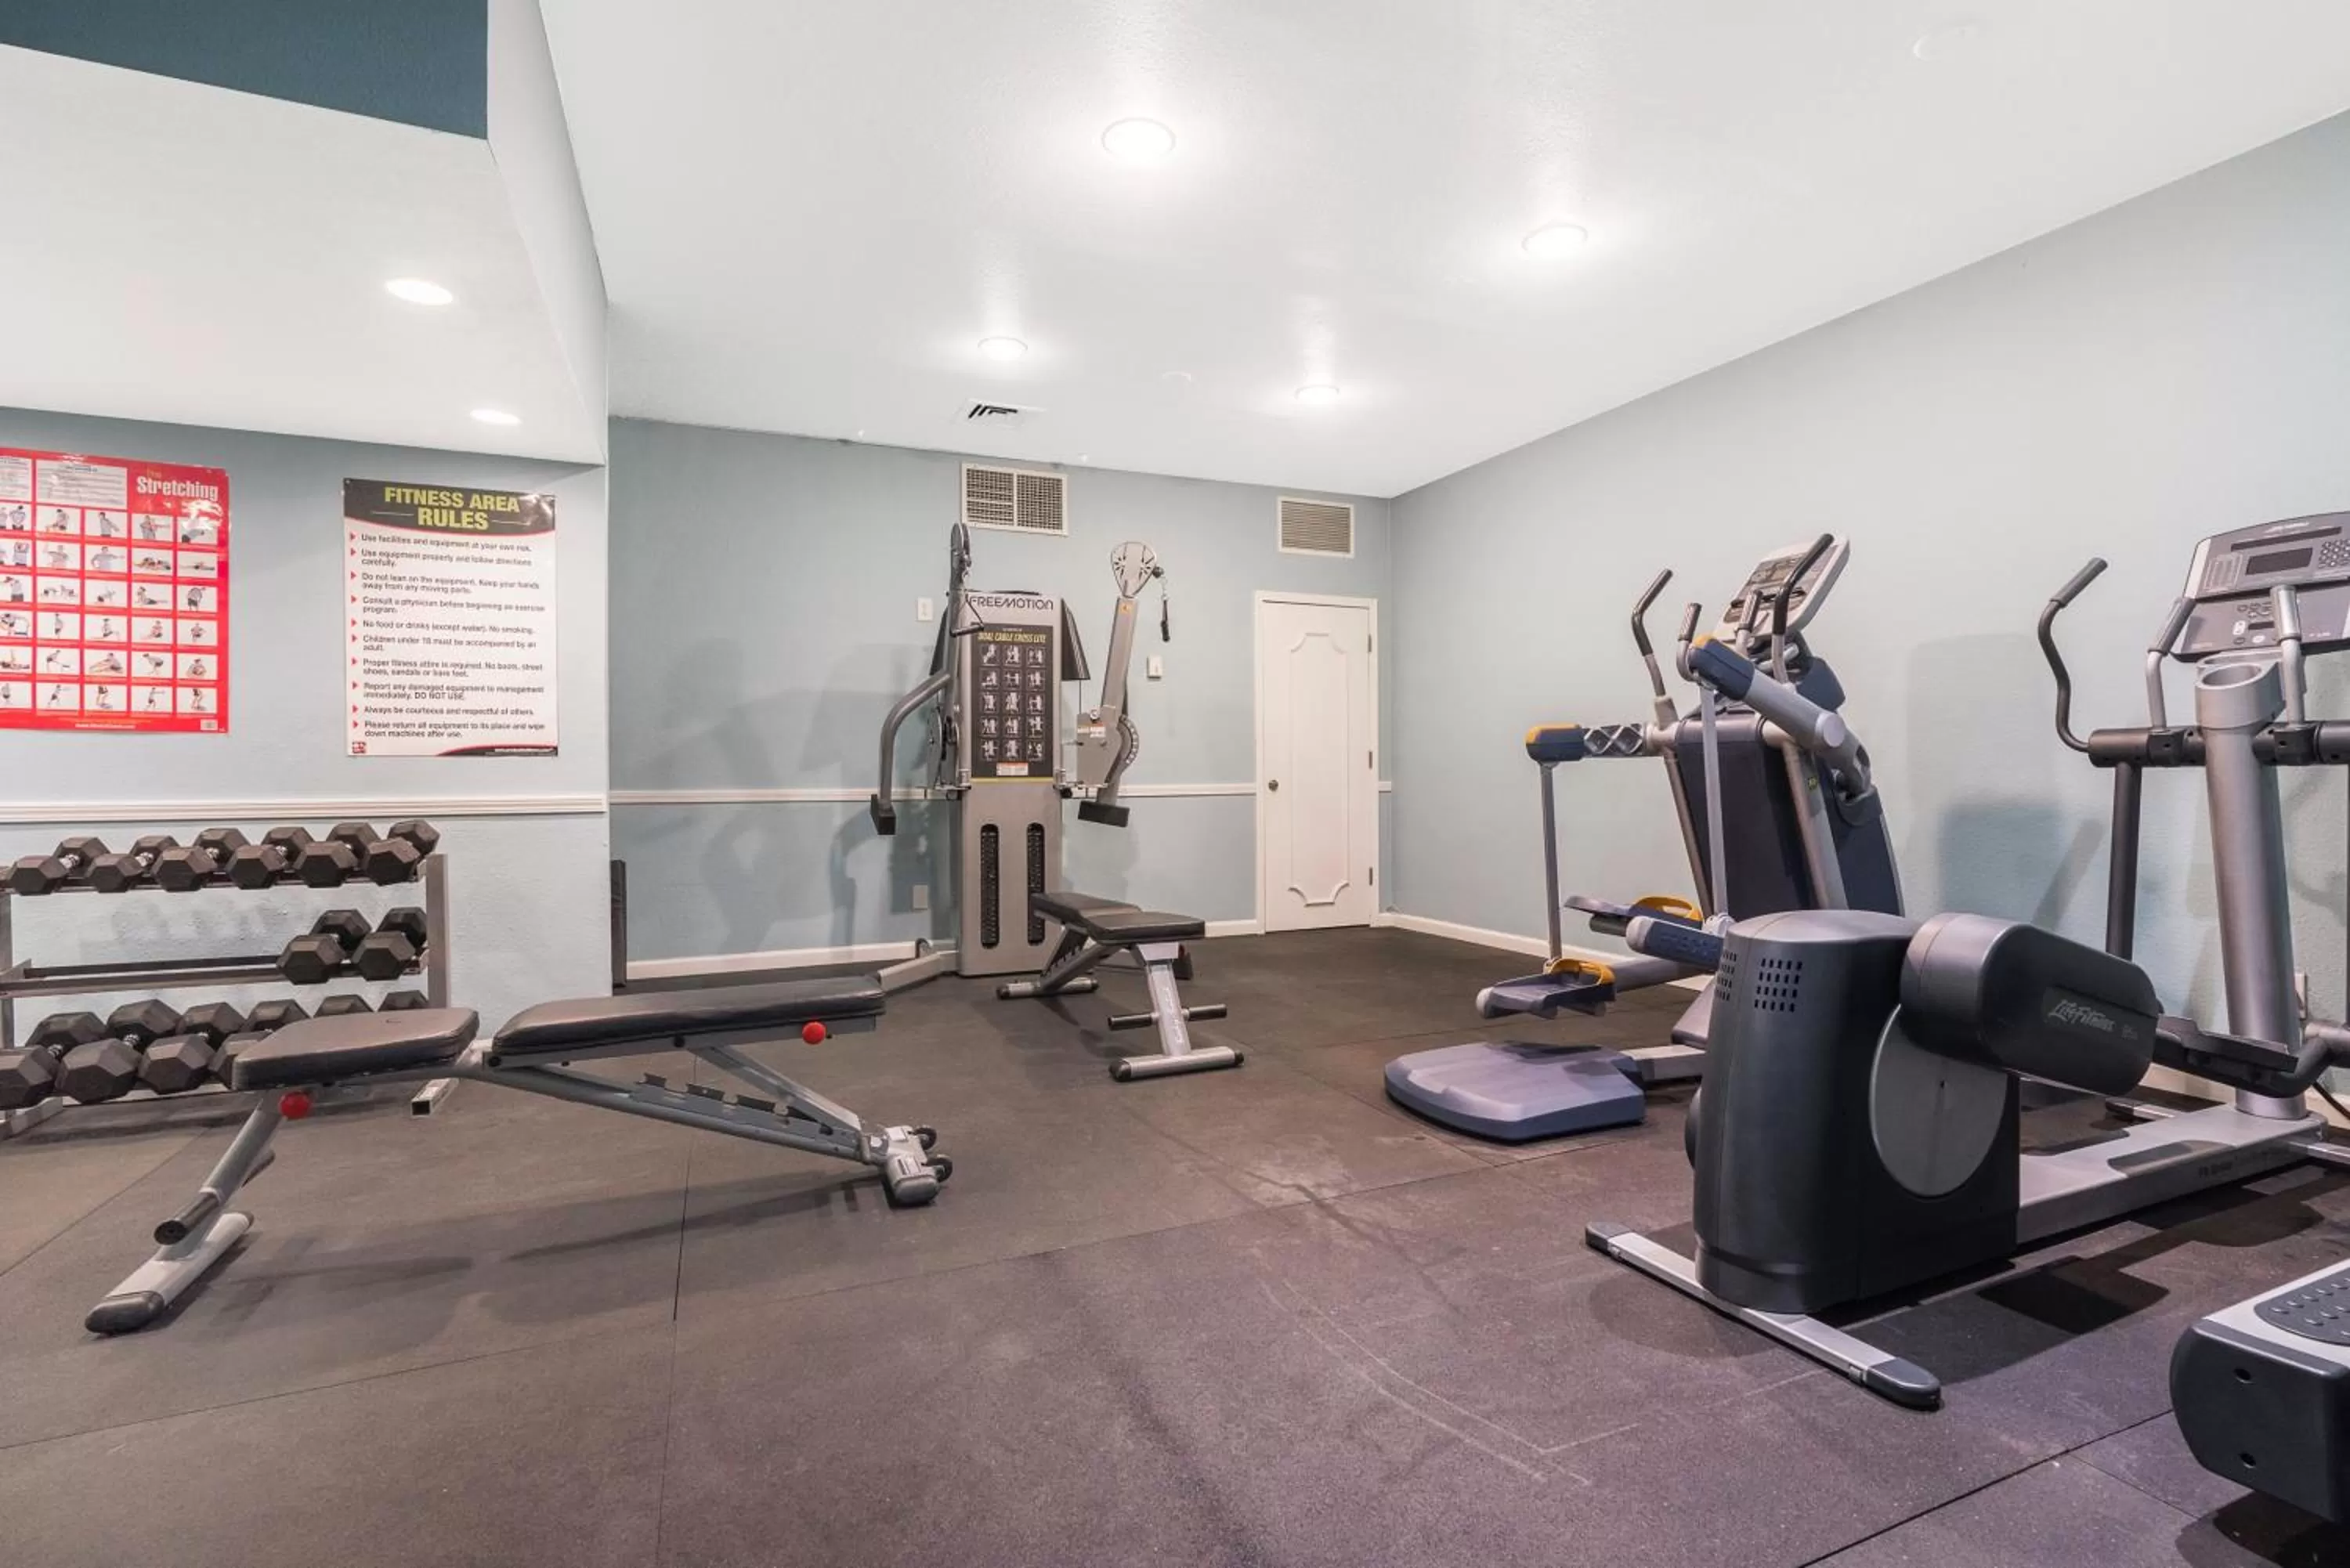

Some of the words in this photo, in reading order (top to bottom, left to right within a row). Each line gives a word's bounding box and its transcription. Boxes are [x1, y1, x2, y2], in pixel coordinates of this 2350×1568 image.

[136, 475, 219, 502] Stretching
[385, 486, 465, 509] FITNESS
[469, 493, 521, 513] AREA
[418, 507, 490, 530] RULES
[361, 533, 377, 542] Use
[361, 548, 377, 557] Use
[363, 582, 383, 591] away
[970, 596, 1054, 611] FREEMOTION
[376, 620, 394, 629] food
[405, 622, 430, 631] drinks
[363, 634, 396, 643] Children
[363, 658, 390, 667] Proper
[364, 706, 392, 714] Always
